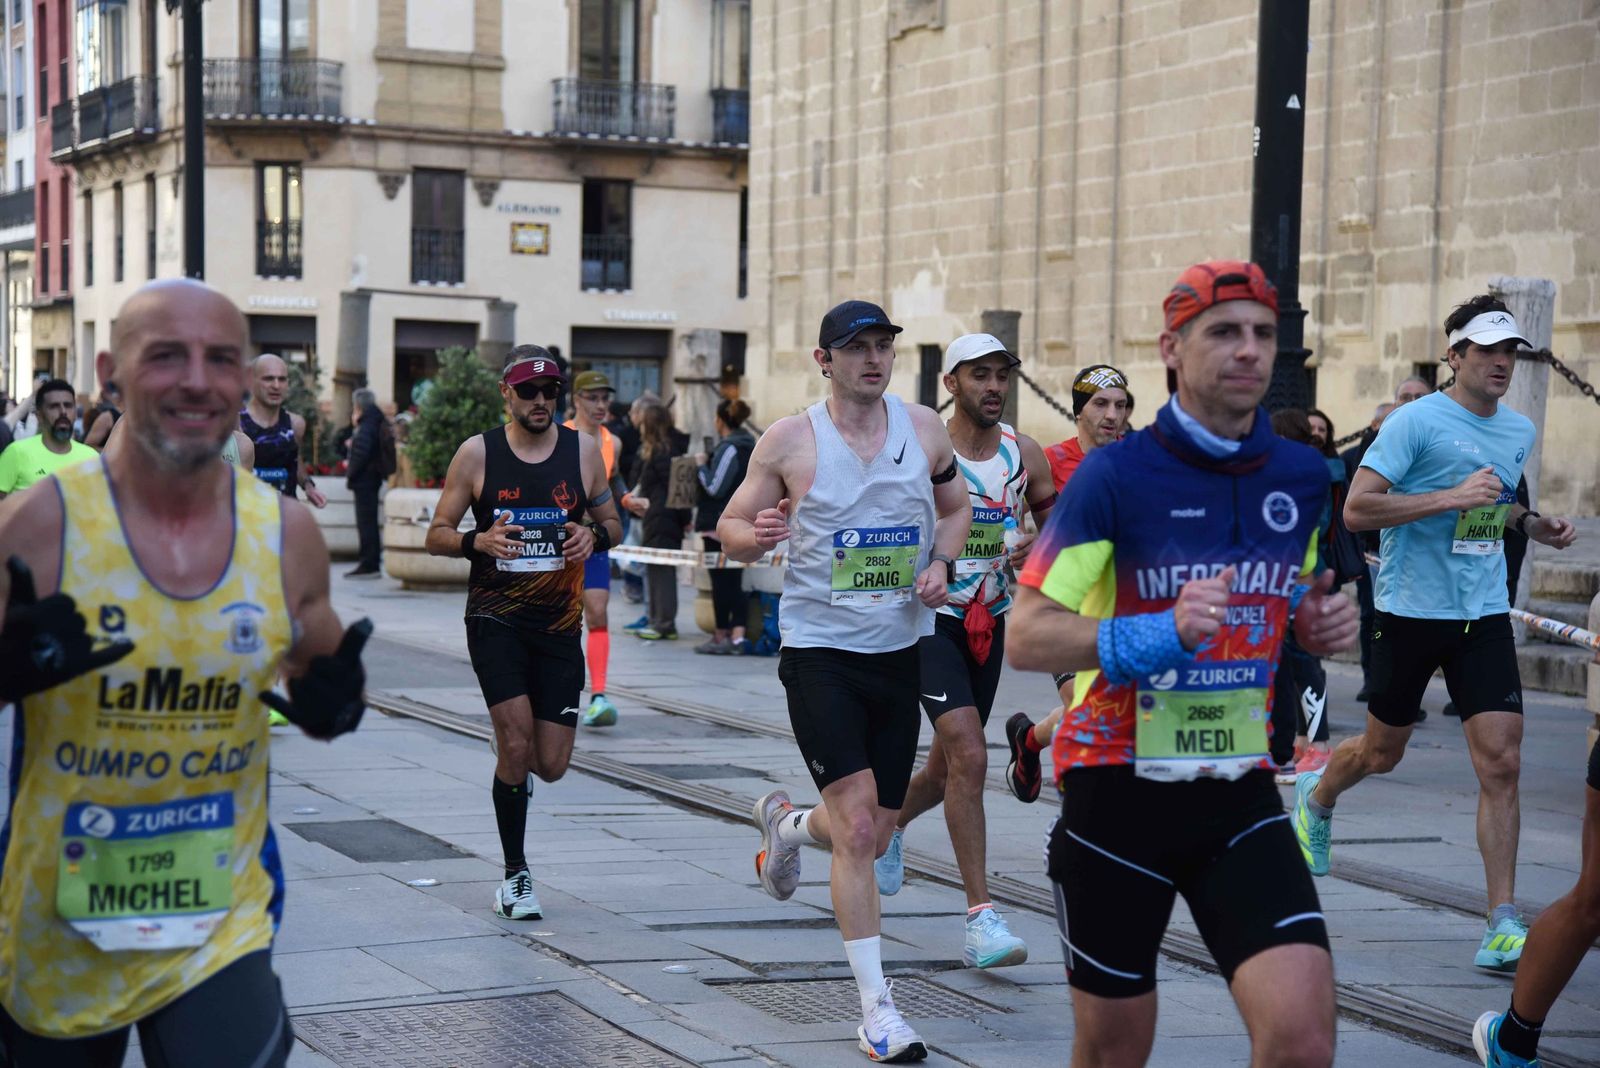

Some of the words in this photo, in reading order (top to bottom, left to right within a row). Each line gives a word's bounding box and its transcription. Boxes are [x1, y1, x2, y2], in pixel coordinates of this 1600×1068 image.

[519, 511, 559, 520] ZURICH
[973, 511, 1003, 521] URICH
[520, 530, 542, 540] 3928
[865, 532, 910, 544] ZURICH
[865, 556, 891, 567] 2882
[853, 571, 900, 588] CRAIG
[1186, 668, 1256, 686] ZURICH
[1187, 705, 1226, 721] 2685
[1175, 729, 1235, 753] MEDI
[55, 741, 171, 779] OLIMPO
[126, 802, 220, 834] ZURICH
[127, 850, 175, 874] 1799
[88, 879, 210, 914] MICHEL
